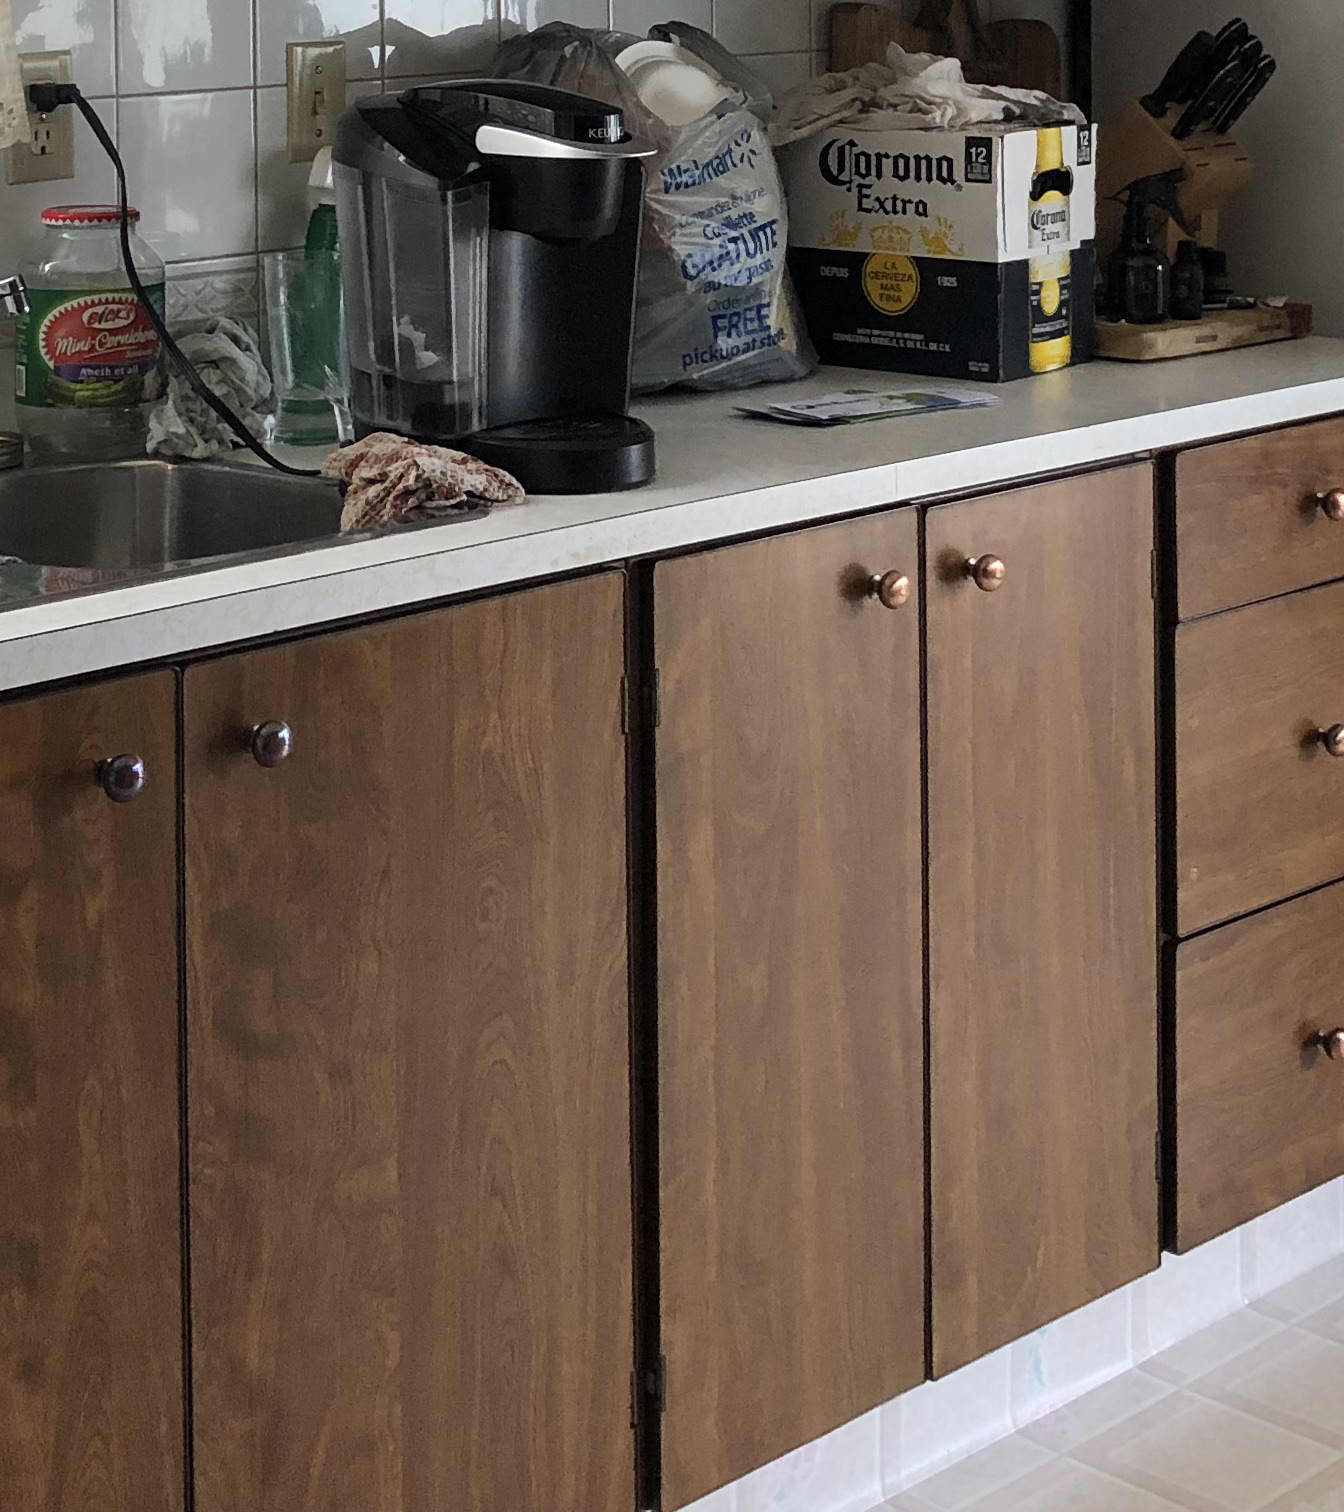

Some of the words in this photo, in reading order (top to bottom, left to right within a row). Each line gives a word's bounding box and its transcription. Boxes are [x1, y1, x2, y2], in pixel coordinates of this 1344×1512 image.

[1079, 130, 1089, 146] 12
[659, 144, 738, 194] Walmart
[819, 138, 957, 192] Corona
[969, 147, 987, 163] 12
[856, 183, 928, 218] Extra
[1031, 209, 1066, 230] Corona
[868, 271, 914, 284] CERVEZA
[712, 302, 771, 342] FREE
